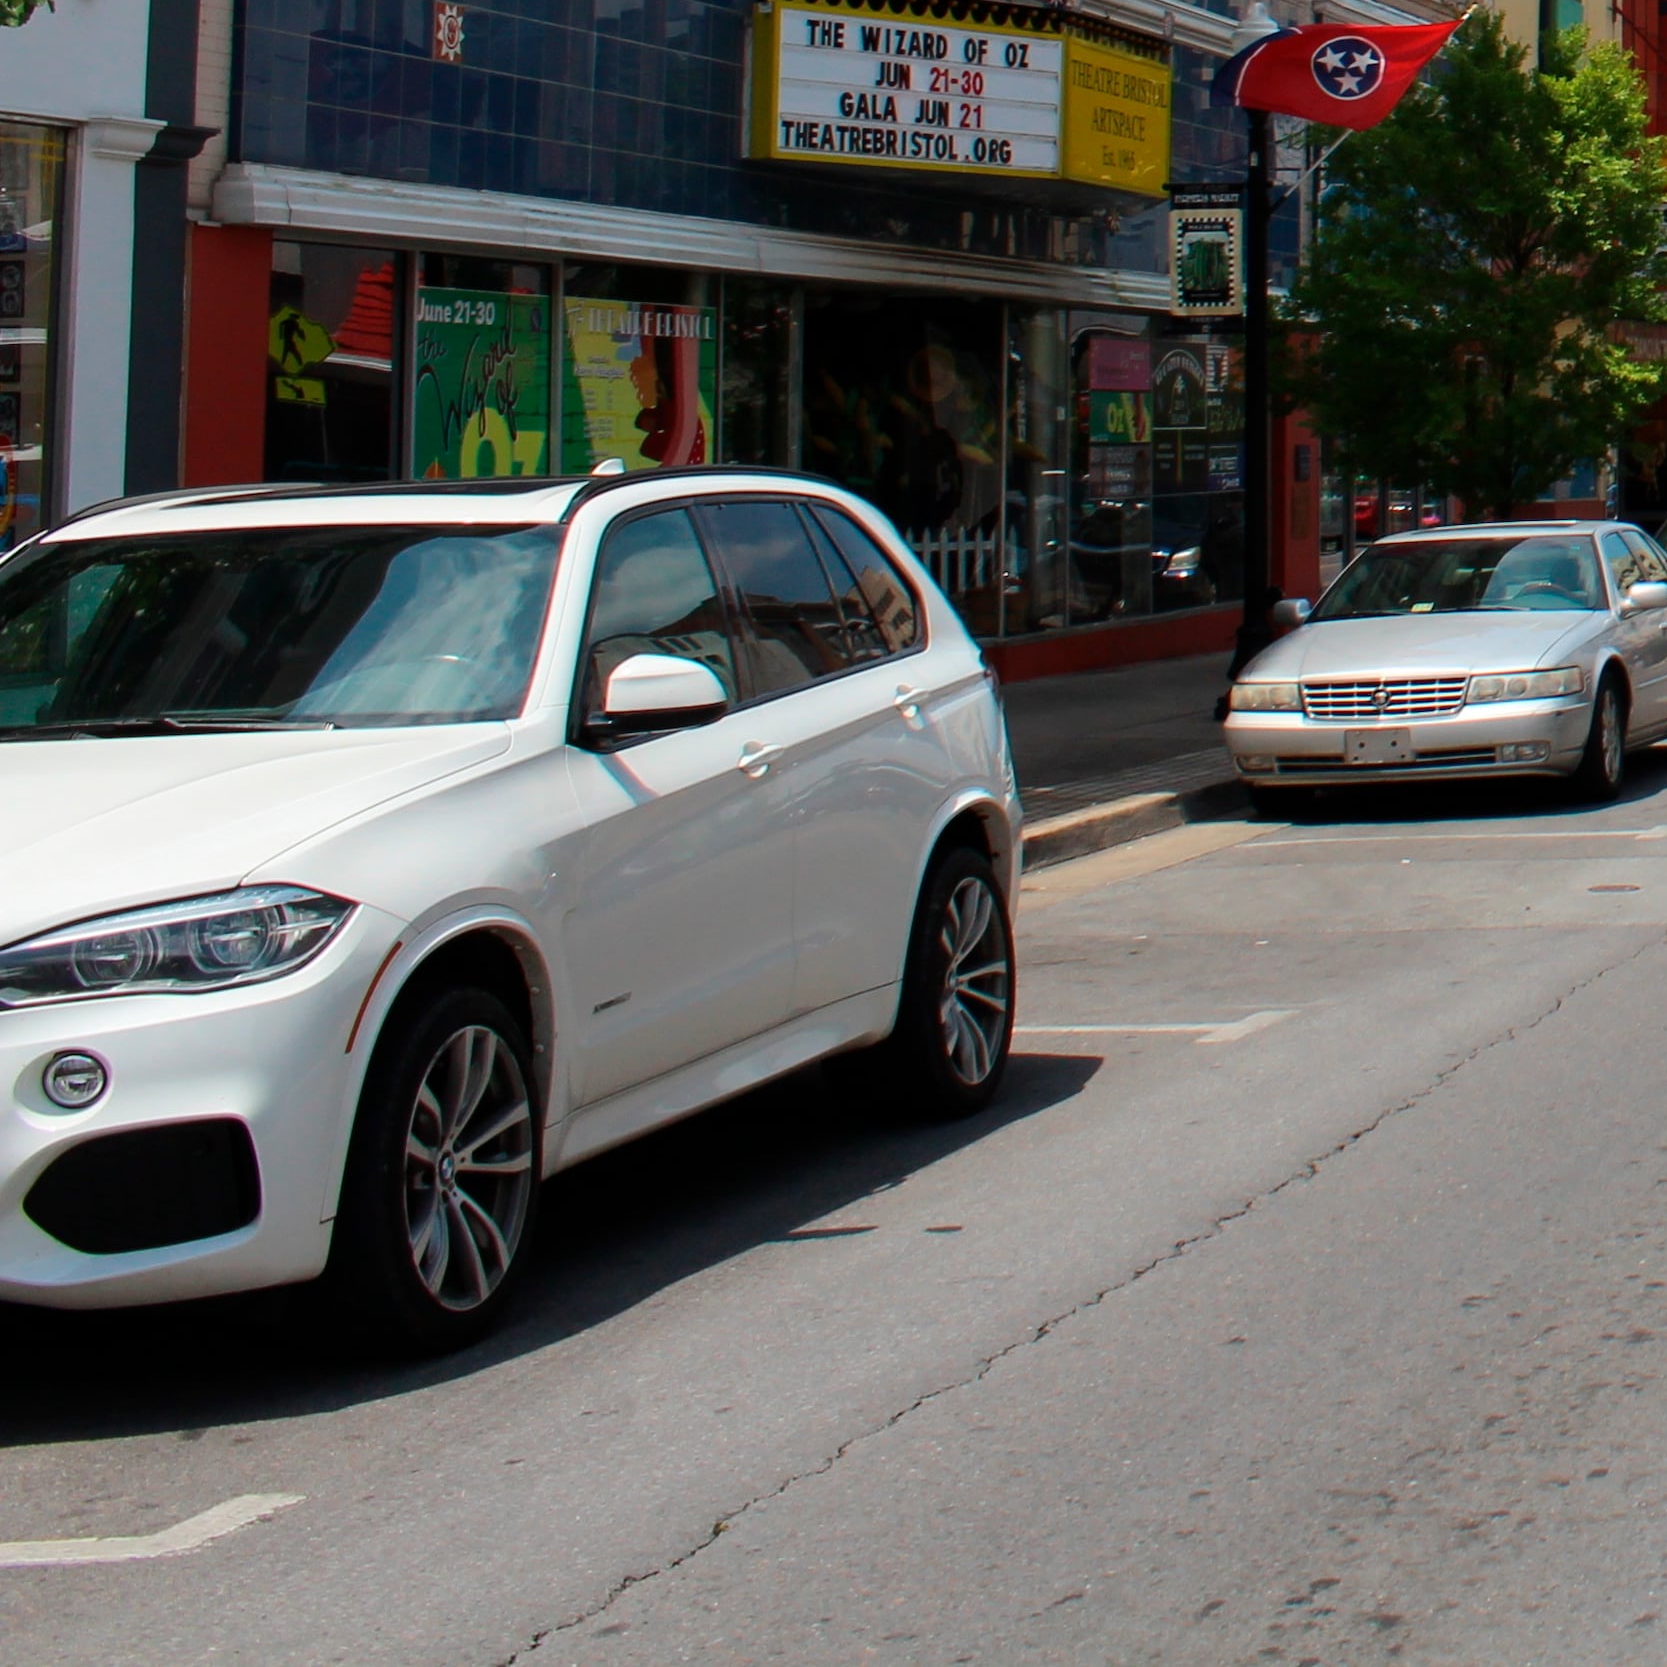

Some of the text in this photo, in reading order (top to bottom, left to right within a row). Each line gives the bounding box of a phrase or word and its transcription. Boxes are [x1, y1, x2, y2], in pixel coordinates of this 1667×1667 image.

[807, 19, 1029, 68] THE WIZARD OF OZ
[875, 62, 984, 95] JUN 21-30
[1071, 60, 1168, 109] THEATRE BRISTOL
[839, 92, 983, 129] GALA JUN 21
[1091, 106, 1146, 142] ARTSPACE
[781, 120, 1012, 164] THEATREBRISTOL.ORG
[416, 297, 496, 326] June 21-30
